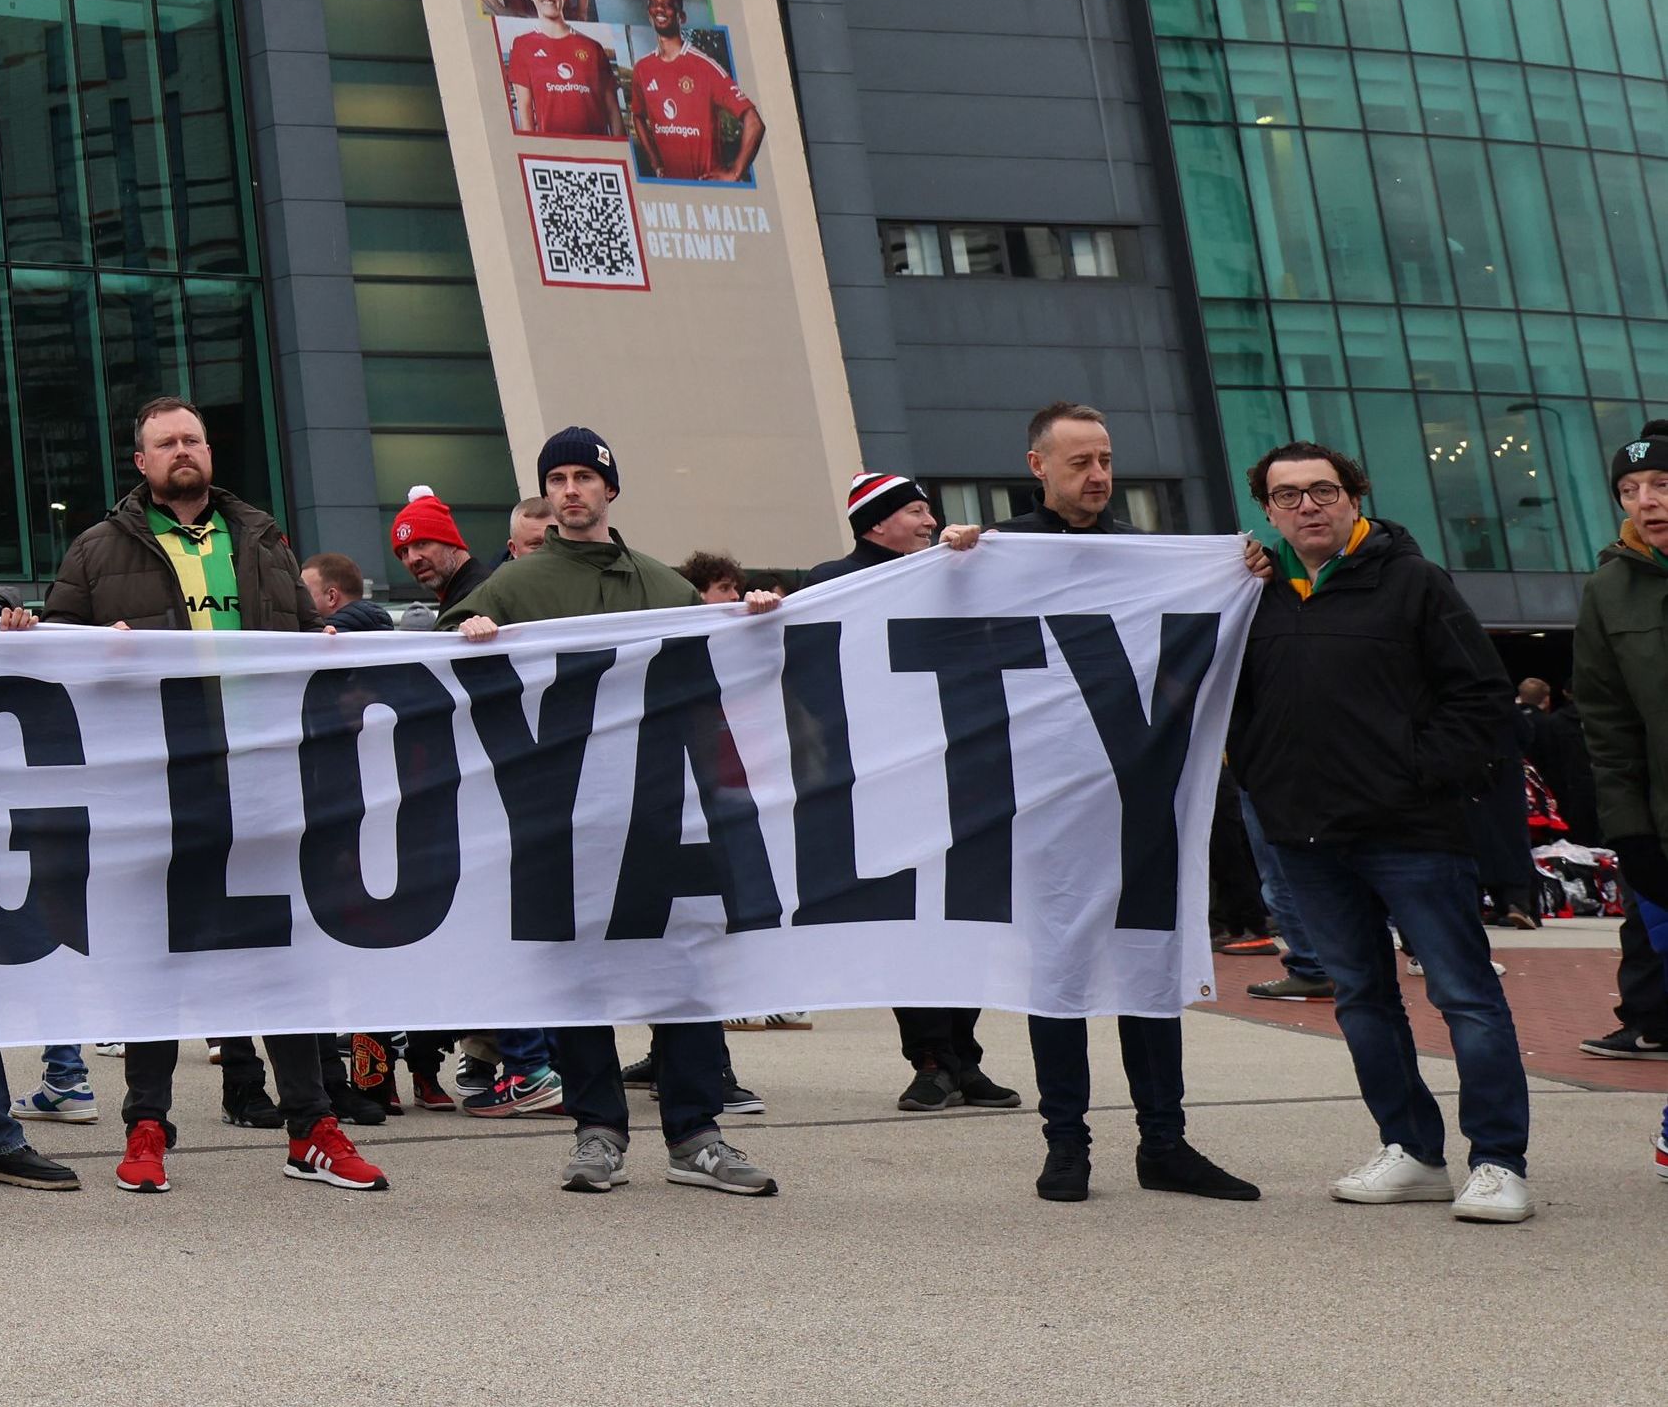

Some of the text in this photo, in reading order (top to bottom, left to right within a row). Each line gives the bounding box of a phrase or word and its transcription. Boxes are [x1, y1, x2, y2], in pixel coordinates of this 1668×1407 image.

[655, 123, 700, 137] Snapdragon
[641, 201, 772, 233] WIN A MALTA
[646, 230, 736, 262] GETAWAY
[160, 611, 1221, 955] LOYALTY
